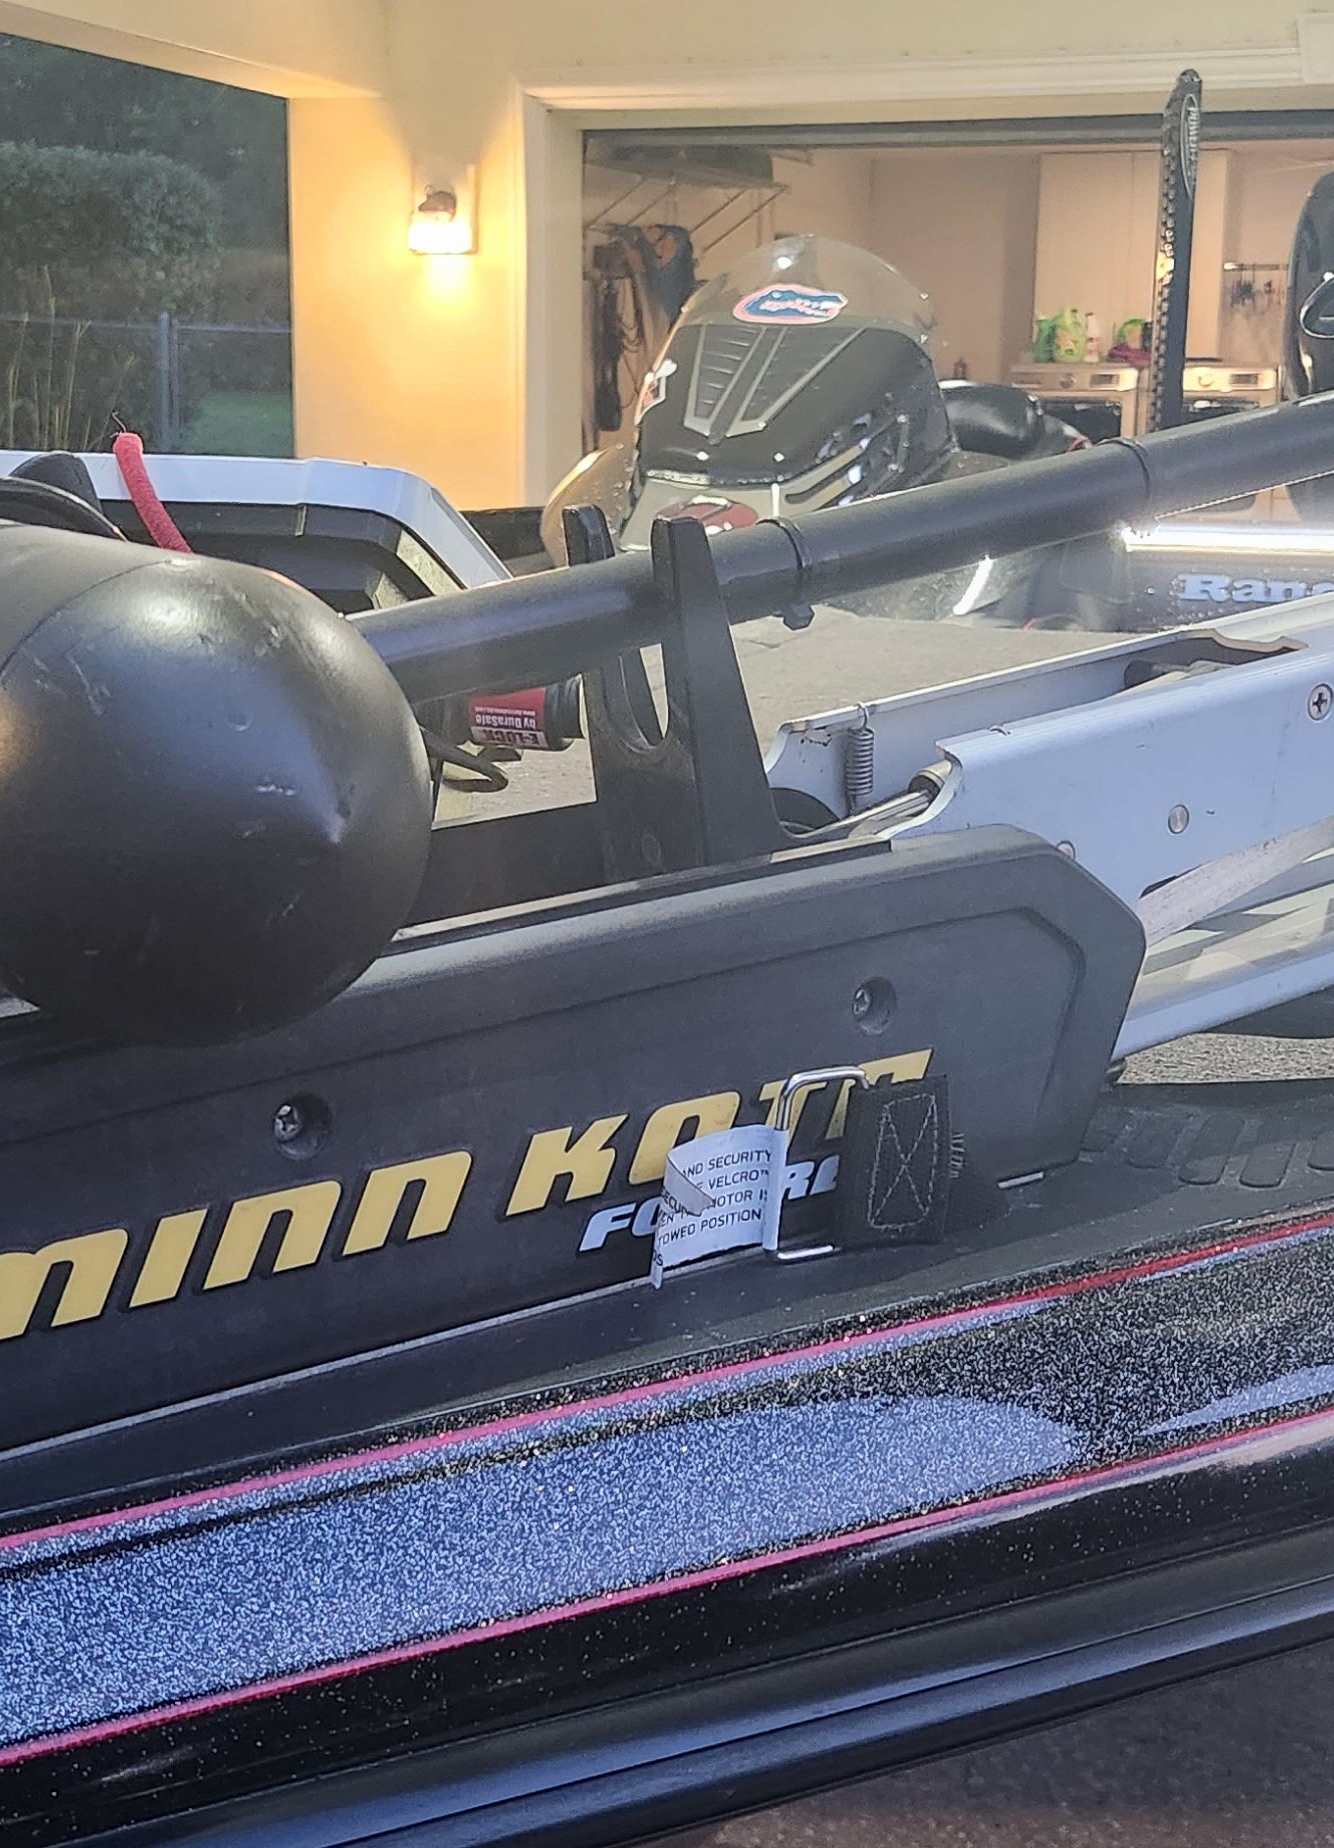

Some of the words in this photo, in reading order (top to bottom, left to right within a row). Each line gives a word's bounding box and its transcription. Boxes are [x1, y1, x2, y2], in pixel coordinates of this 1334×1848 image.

[682, 1162, 704, 1178] ND
[707, 1149, 772, 1172] SECURITY
[713, 1189, 753, 1209] OTOR
[700, 1207, 762, 1233] POSITION
